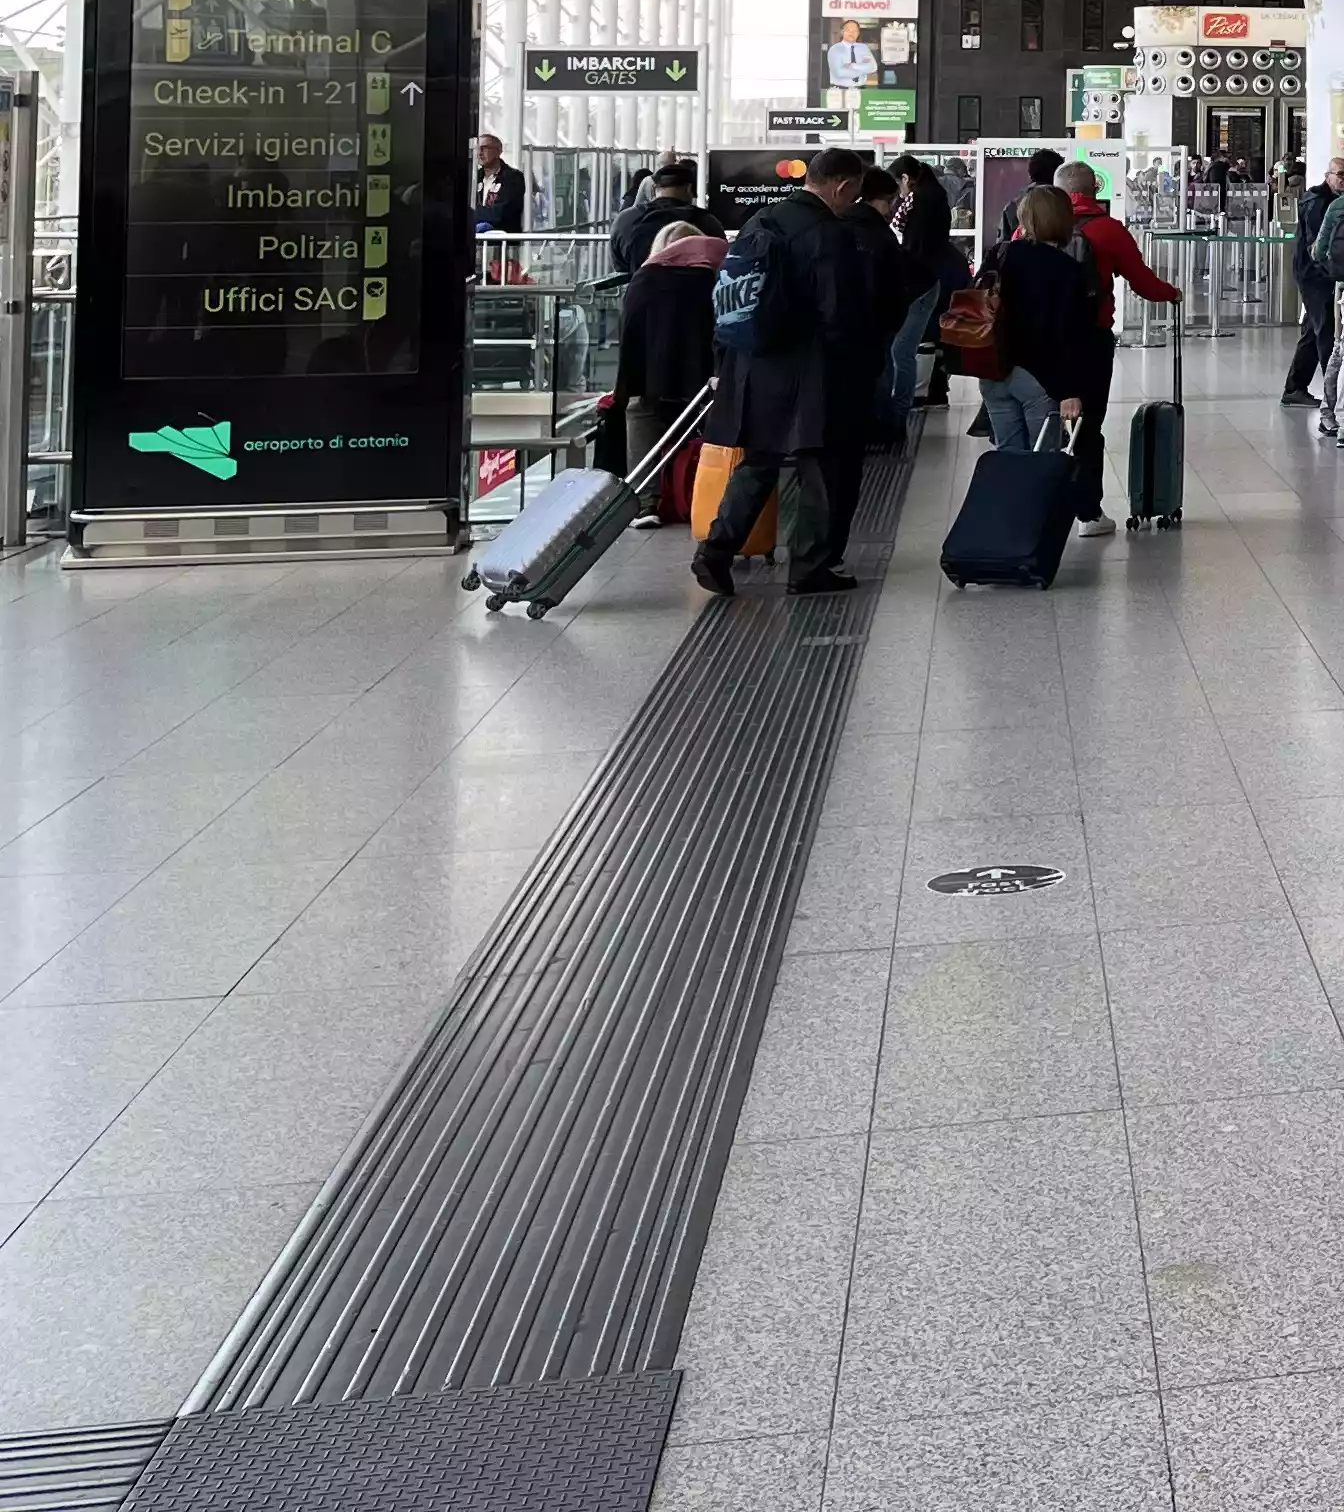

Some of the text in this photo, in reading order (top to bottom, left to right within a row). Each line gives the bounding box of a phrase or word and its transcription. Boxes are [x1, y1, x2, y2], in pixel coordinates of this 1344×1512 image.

[228, 29, 393, 55] Terminal C
[566, 56, 656, 71] IMBARCHI
[584, 70, 638, 85] GATES
[153, 79, 358, 105] Check-in 1-21
[772, 116, 825, 126] FAST TRACK
[144, 131, 362, 162] Servizi igienici
[226, 183, 361, 208] Imbarchi
[719, 184, 736, 193] Per
[734, 196, 759, 205] segui
[258, 234, 359, 260] Polizia
[203, 286, 359, 313] Uffici SAC
[243, 433, 409, 454] aeroporto di catania
